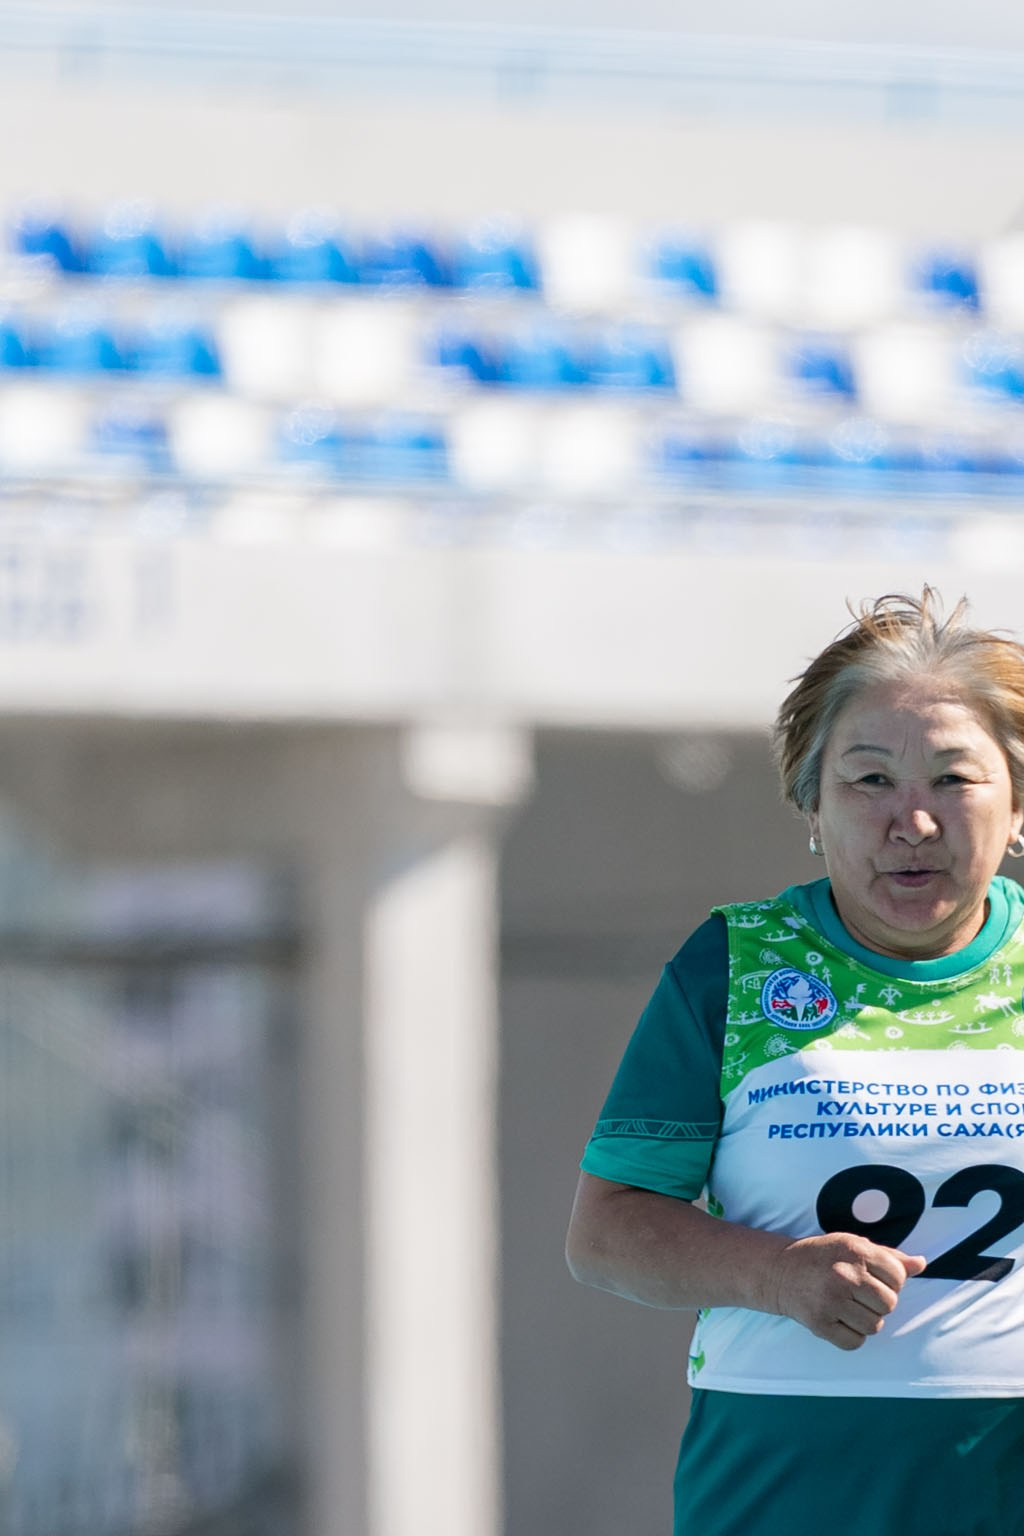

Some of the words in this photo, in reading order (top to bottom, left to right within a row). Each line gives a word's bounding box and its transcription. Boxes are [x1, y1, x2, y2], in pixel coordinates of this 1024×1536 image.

[747, 1079, 928, 1105] МИНИСТЕРСТВО
[936, 1084, 970, 1096] ПО
[816, 1101, 938, 1116] КУЛЬТУРЕ
[946, 1103, 963, 1116] И
[767, 1122, 929, 1139] РЕСПУБЛИКИ
